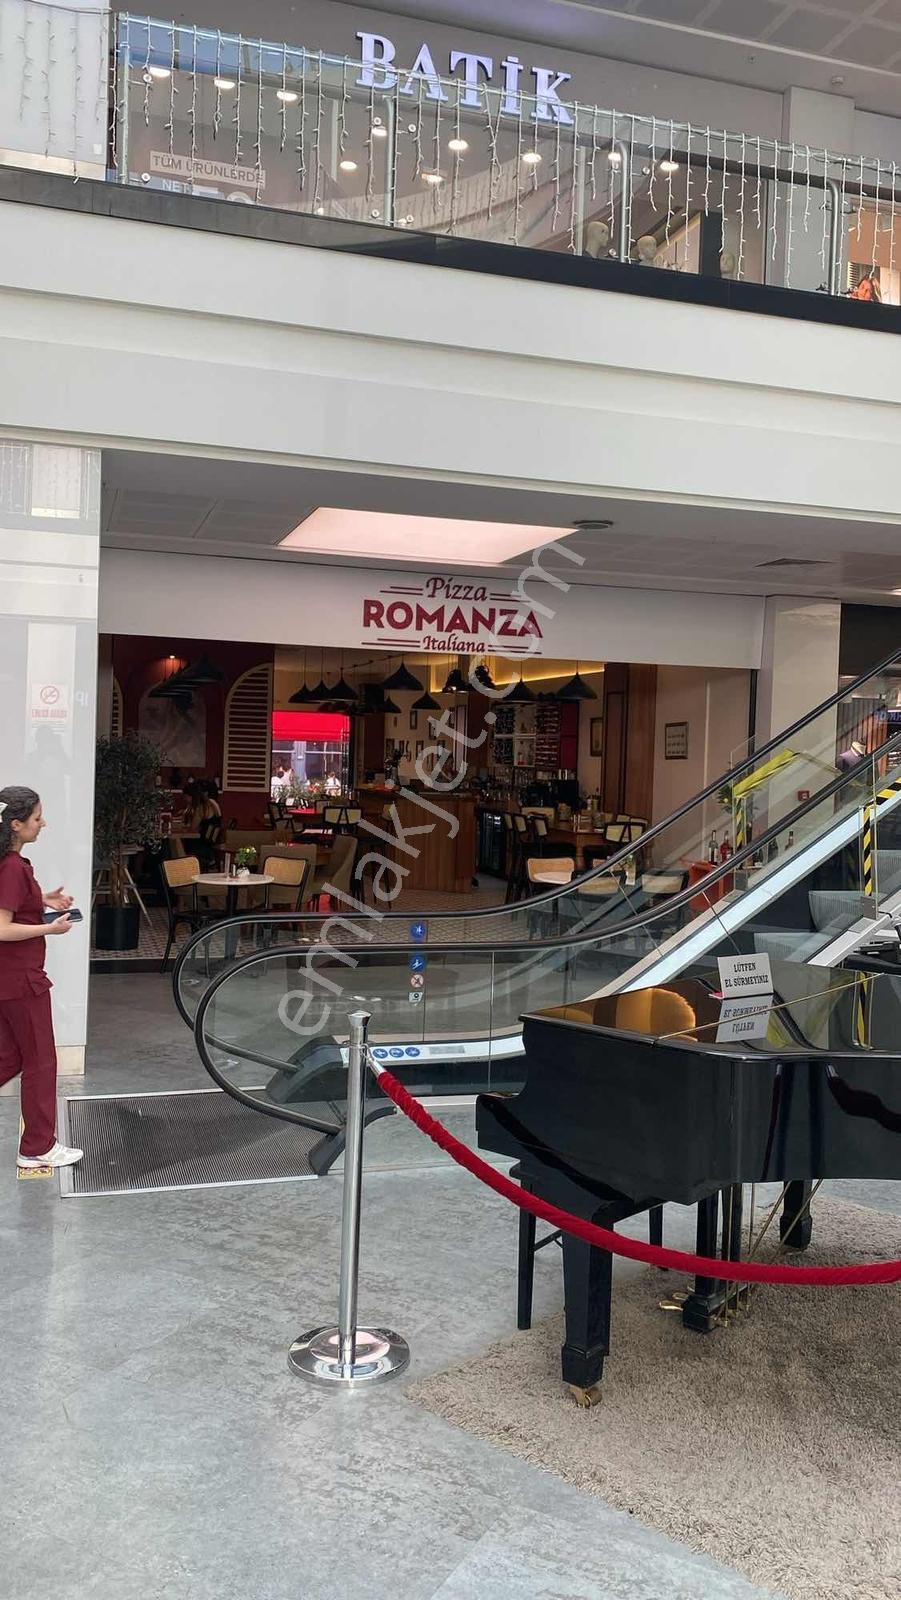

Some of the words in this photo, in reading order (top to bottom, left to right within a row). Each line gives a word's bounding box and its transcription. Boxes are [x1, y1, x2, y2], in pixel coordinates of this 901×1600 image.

[355, 31, 574, 126] BATİK
[152, 153, 182, 170] TÜM
[426, 577, 488, 601] Pizza
[363, 599, 543, 638] ROMANZA
[423, 633, 485, 653] Italiana
[733, 962, 756, 973] LÜTFEN
[724, 979, 733, 988] EL
